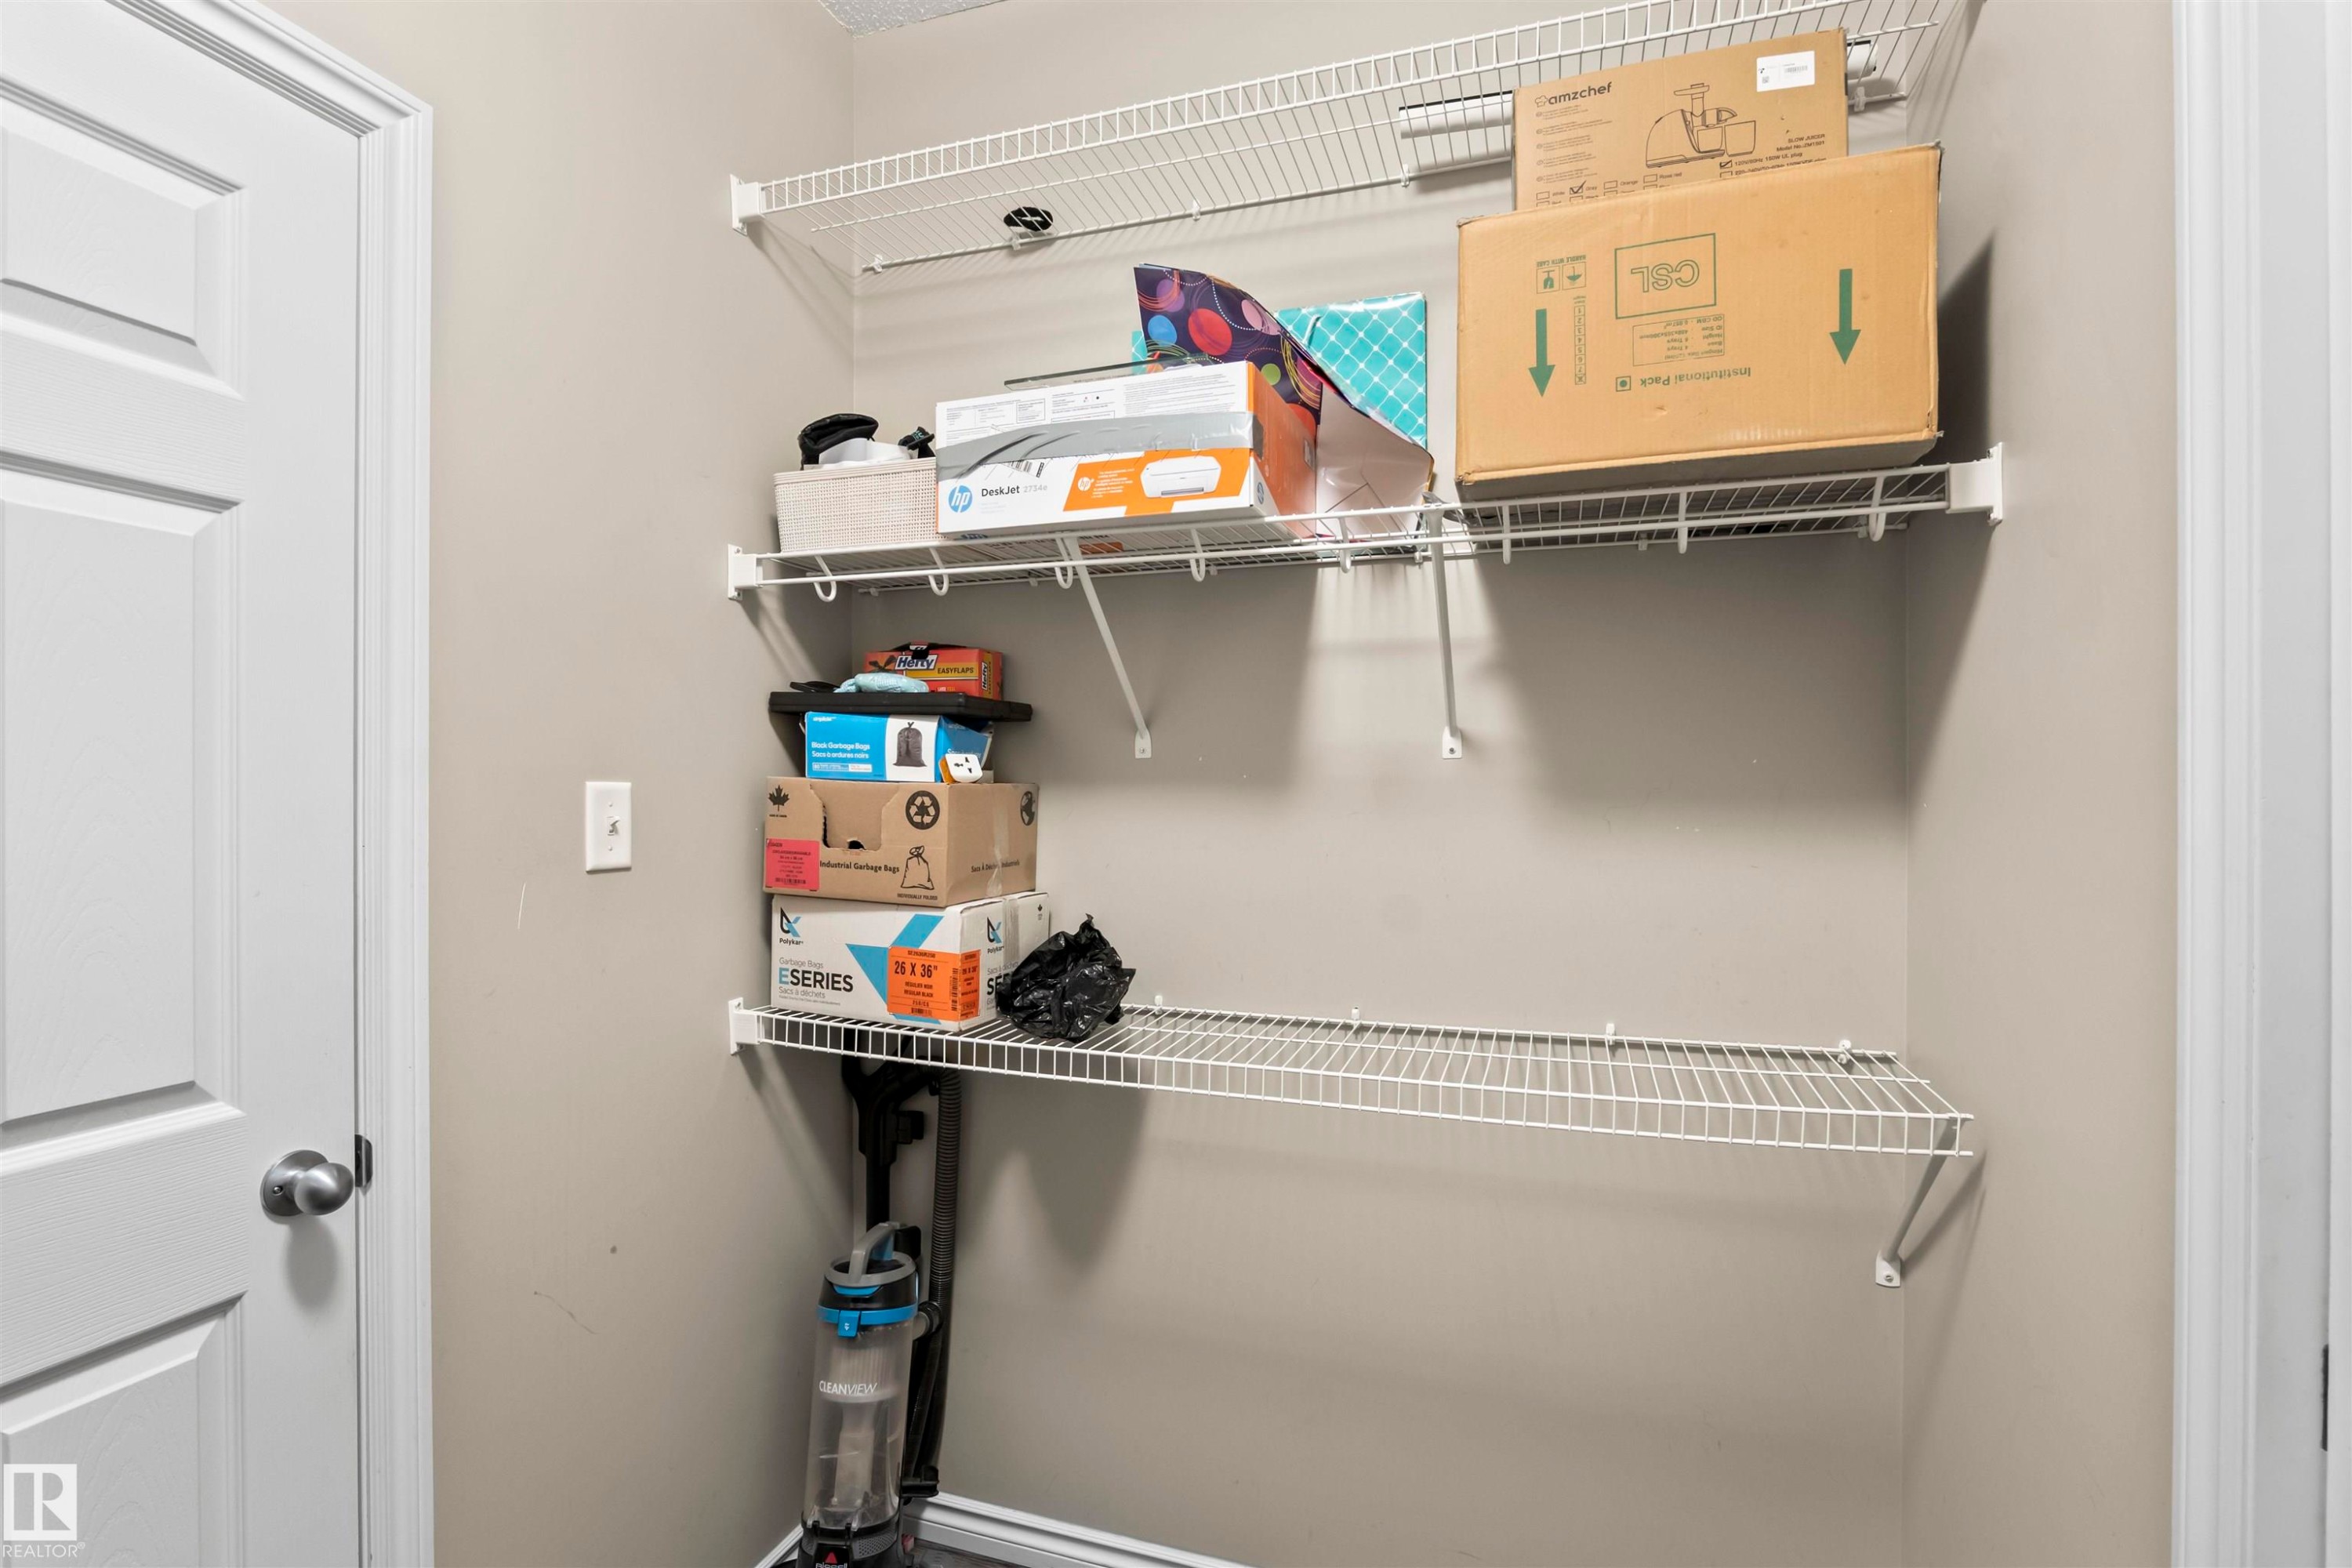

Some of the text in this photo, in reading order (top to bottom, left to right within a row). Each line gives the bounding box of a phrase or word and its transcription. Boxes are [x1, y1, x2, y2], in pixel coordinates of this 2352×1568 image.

[1548, 82, 1613, 104] amzchef
[1806, 133, 1826, 142] JUICER
[1631, 260, 1700, 292] CSL
[1640, 367, 1751, 387] Institutional Pack
[950, 485, 972, 514] hp
[982, 485, 1020, 497] DeskJet
[1023, 485, 1048, 493] 2734e
[828, 742, 855, 750] Garbage
[855, 742, 870, 751] Bags
[819, 861, 900, 874] Industrial Garbage Bags
[779, 957, 824, 970] Garbage Bags
[895, 960, 938, 978] 26 X 36"
[779, 967, 854, 993] ESERIES
[779, 986, 794, 996] Sacs
[800, 989, 826, 999] déchets
[818, 1380, 878, 1396] CLEANVIEW
